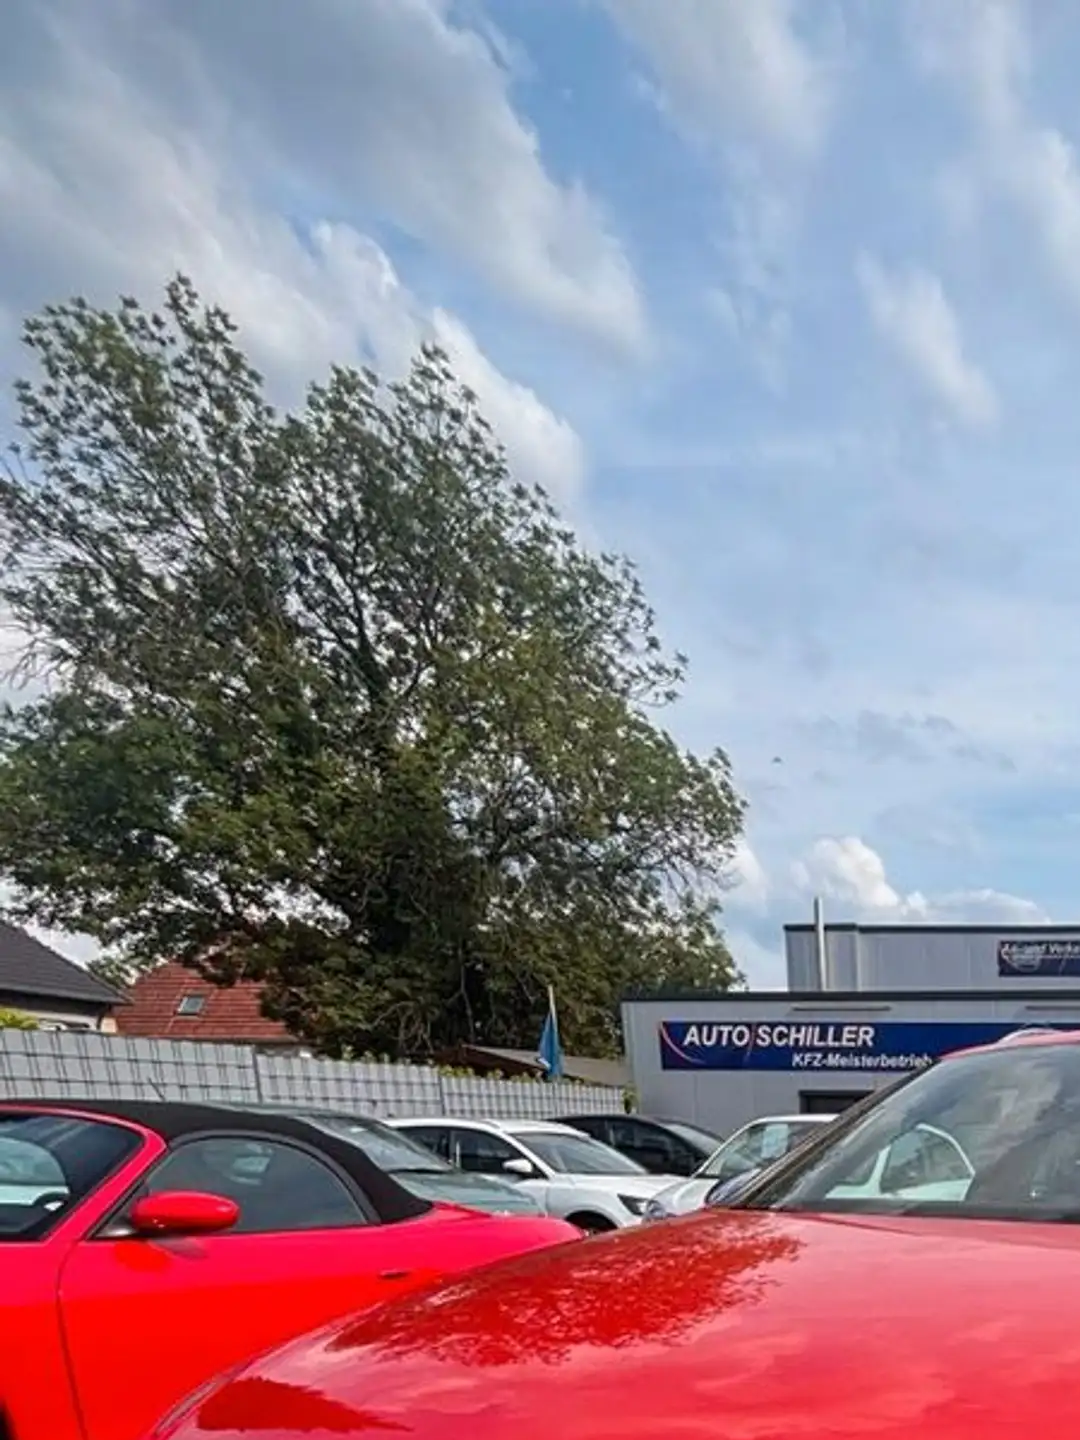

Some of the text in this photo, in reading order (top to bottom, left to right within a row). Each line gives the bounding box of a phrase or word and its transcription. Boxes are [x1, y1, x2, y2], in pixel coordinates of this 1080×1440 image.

[683, 1025, 875, 1047] AUTO SCHILLER
[792, 1052, 933, 1068] KFZ-Meisterbetrieb
